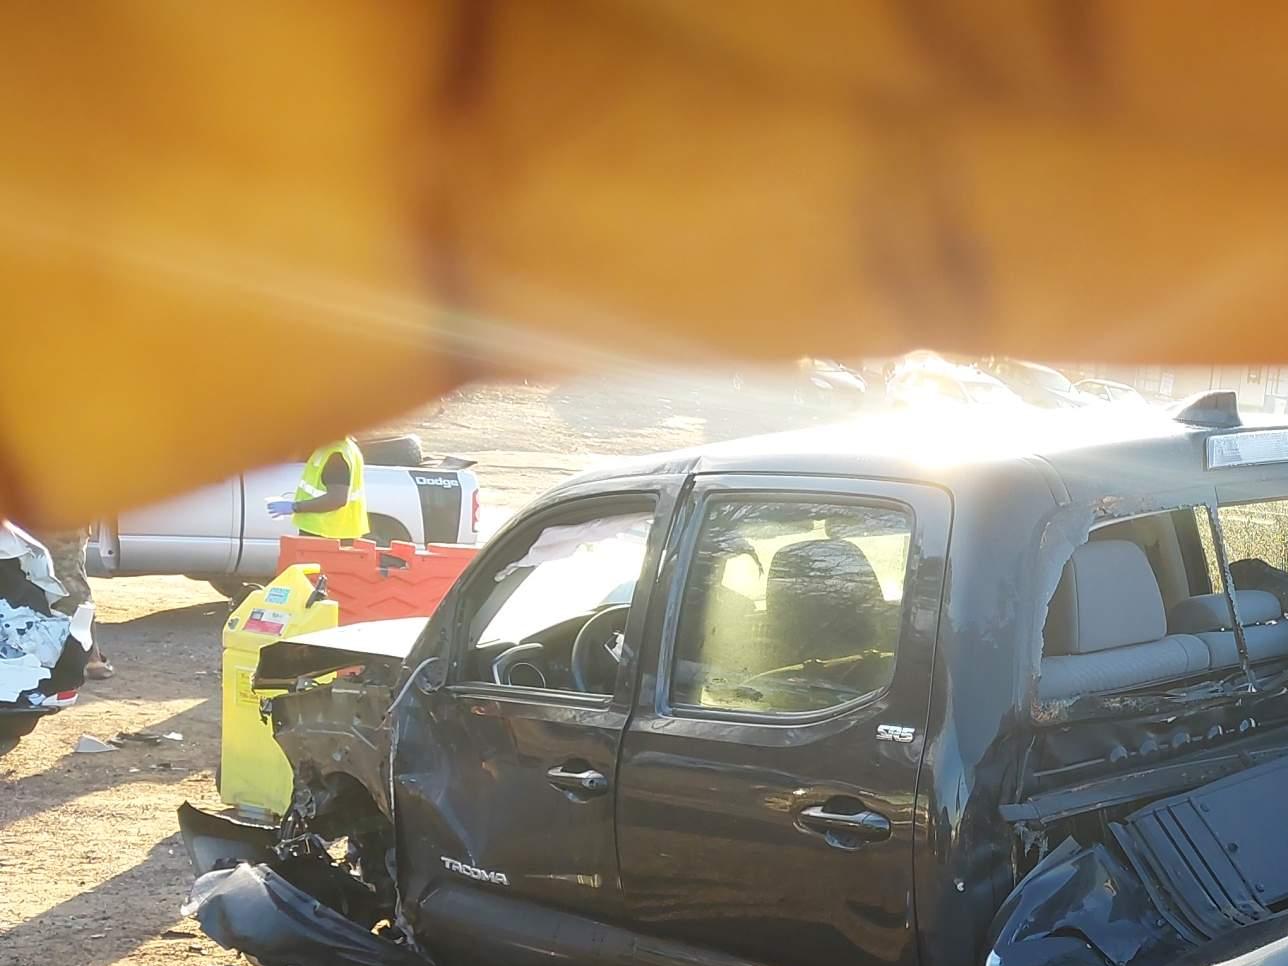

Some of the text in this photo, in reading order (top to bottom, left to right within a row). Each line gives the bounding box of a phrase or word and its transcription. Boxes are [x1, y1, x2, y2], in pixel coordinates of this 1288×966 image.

[415, 476, 459, 489] Dodge
[876, 724, 916, 743] SR5
[440, 856, 511, 886] TACOMA
